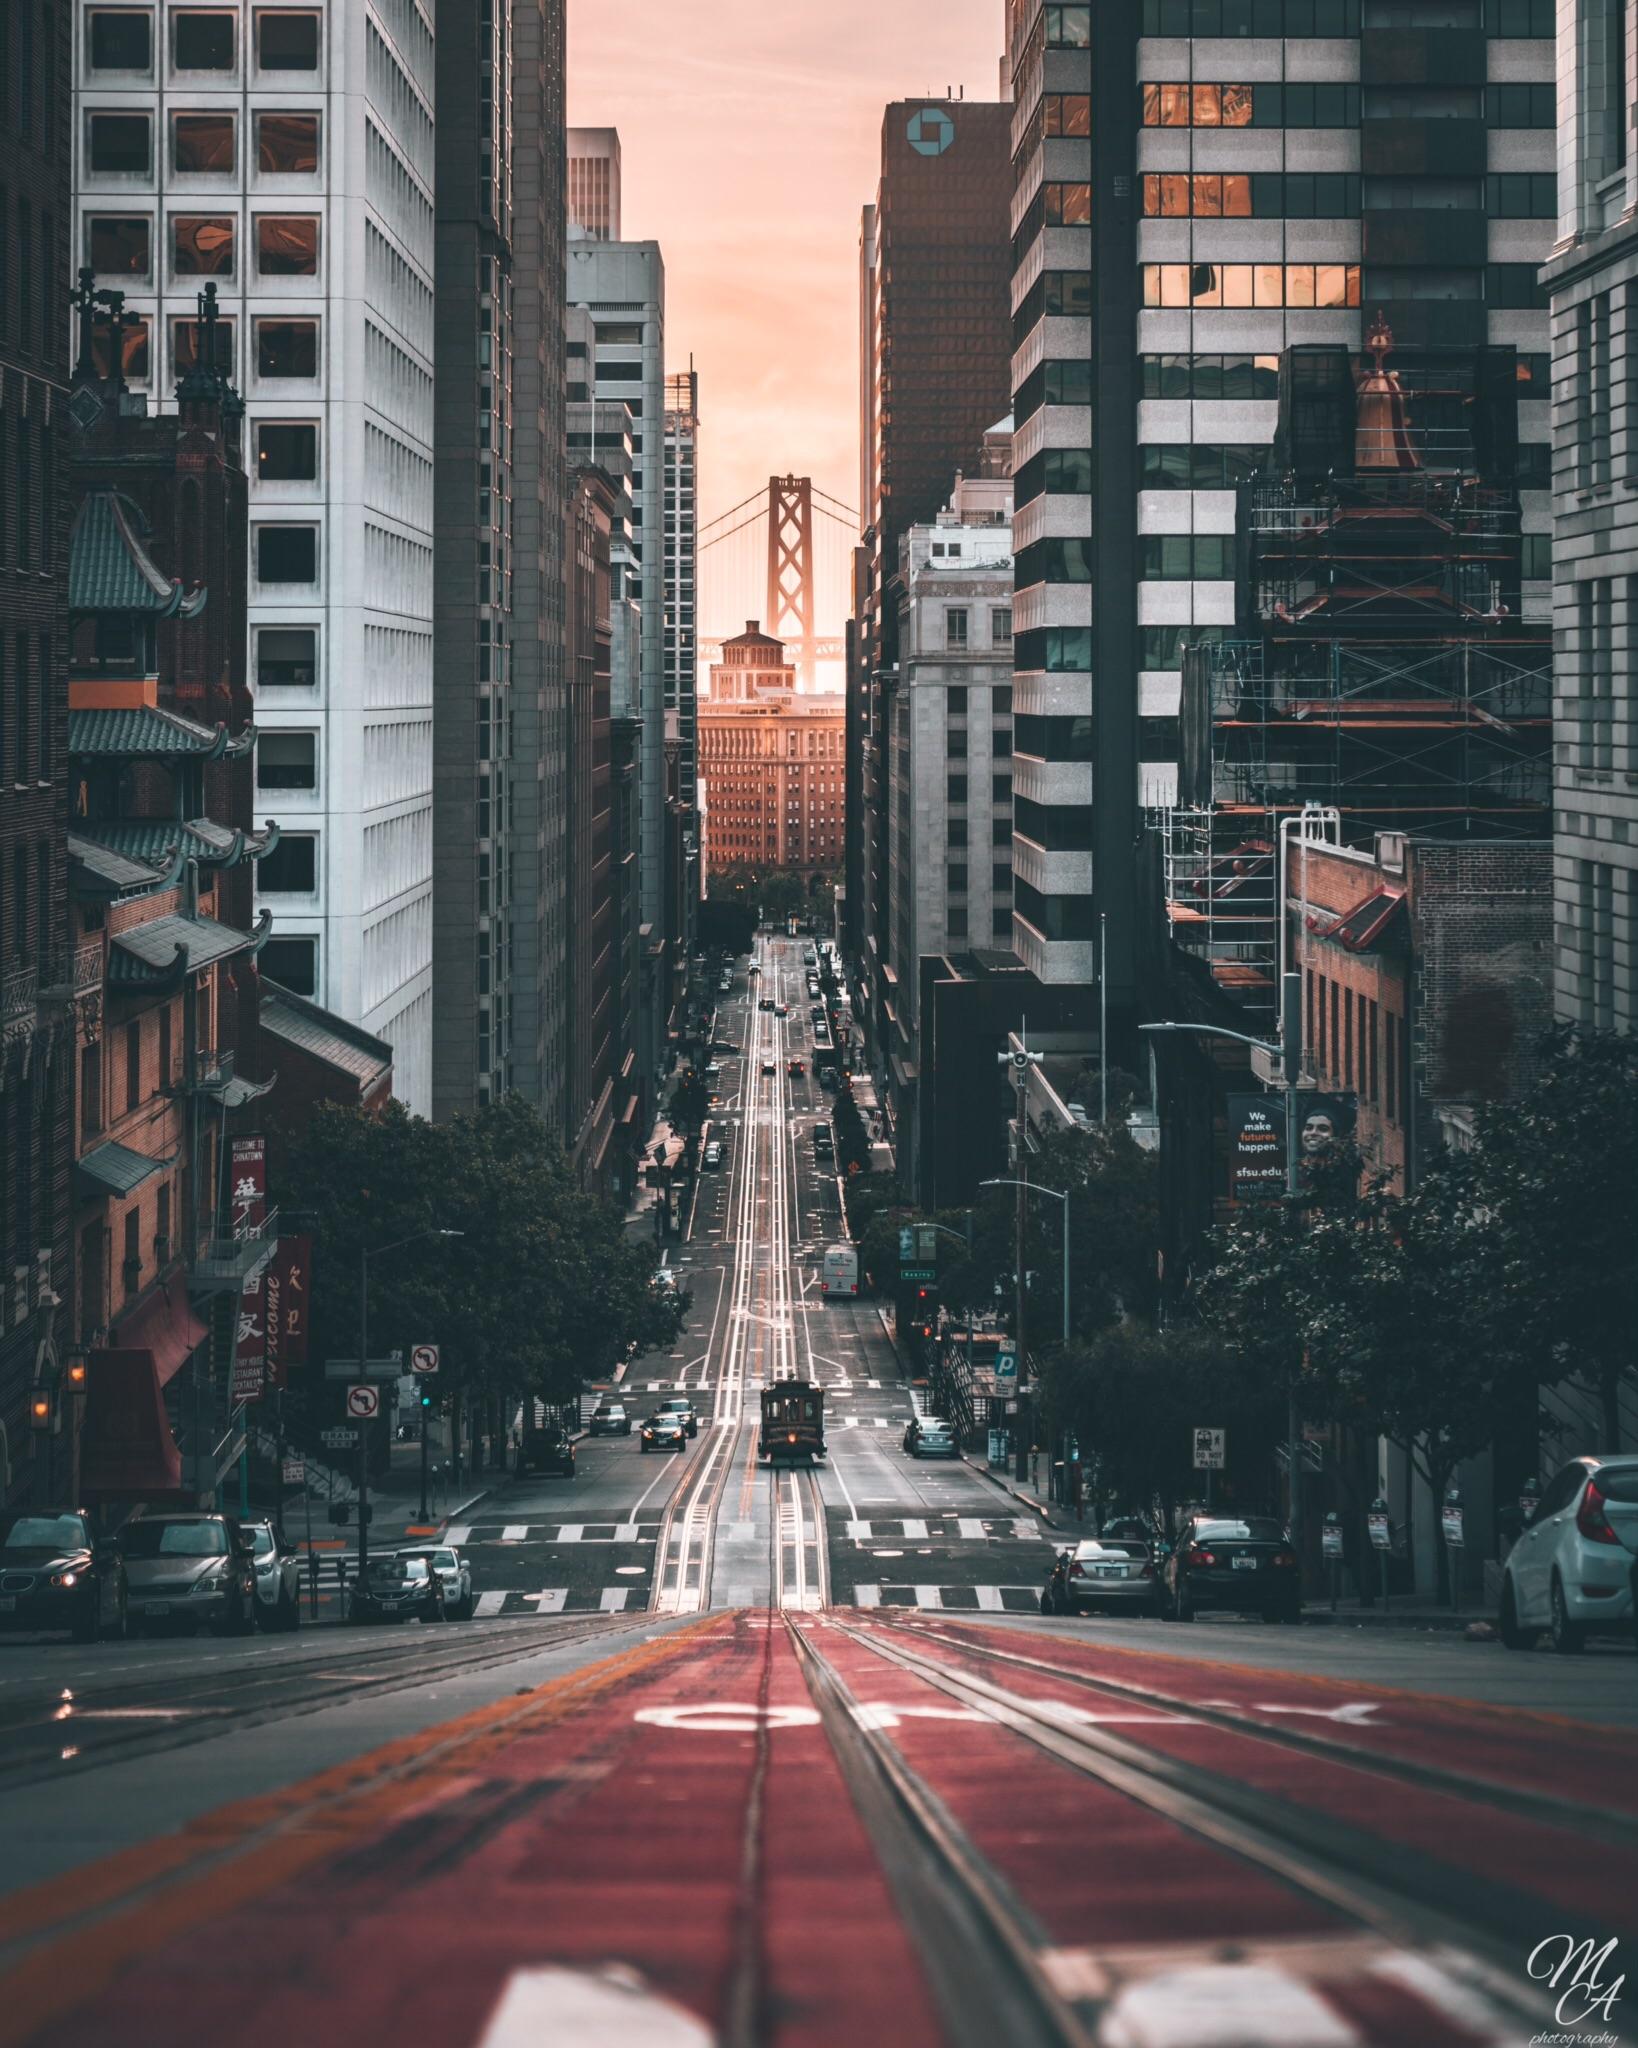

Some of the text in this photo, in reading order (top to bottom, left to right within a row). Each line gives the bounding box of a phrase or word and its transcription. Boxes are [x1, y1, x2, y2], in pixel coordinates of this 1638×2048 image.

[1249, 1112, 1266, 1121] We
[1244, 1122, 1272, 1131] make
[1240, 1132, 1277, 1142] futures
[232, 1139, 265, 1152] WELCOME TO
[1238, 1142, 1279, 1153] happen.
[233, 1151, 263, 1163] CHINATOWN
[1236, 1167, 1282, 1177] sfsu.edu
